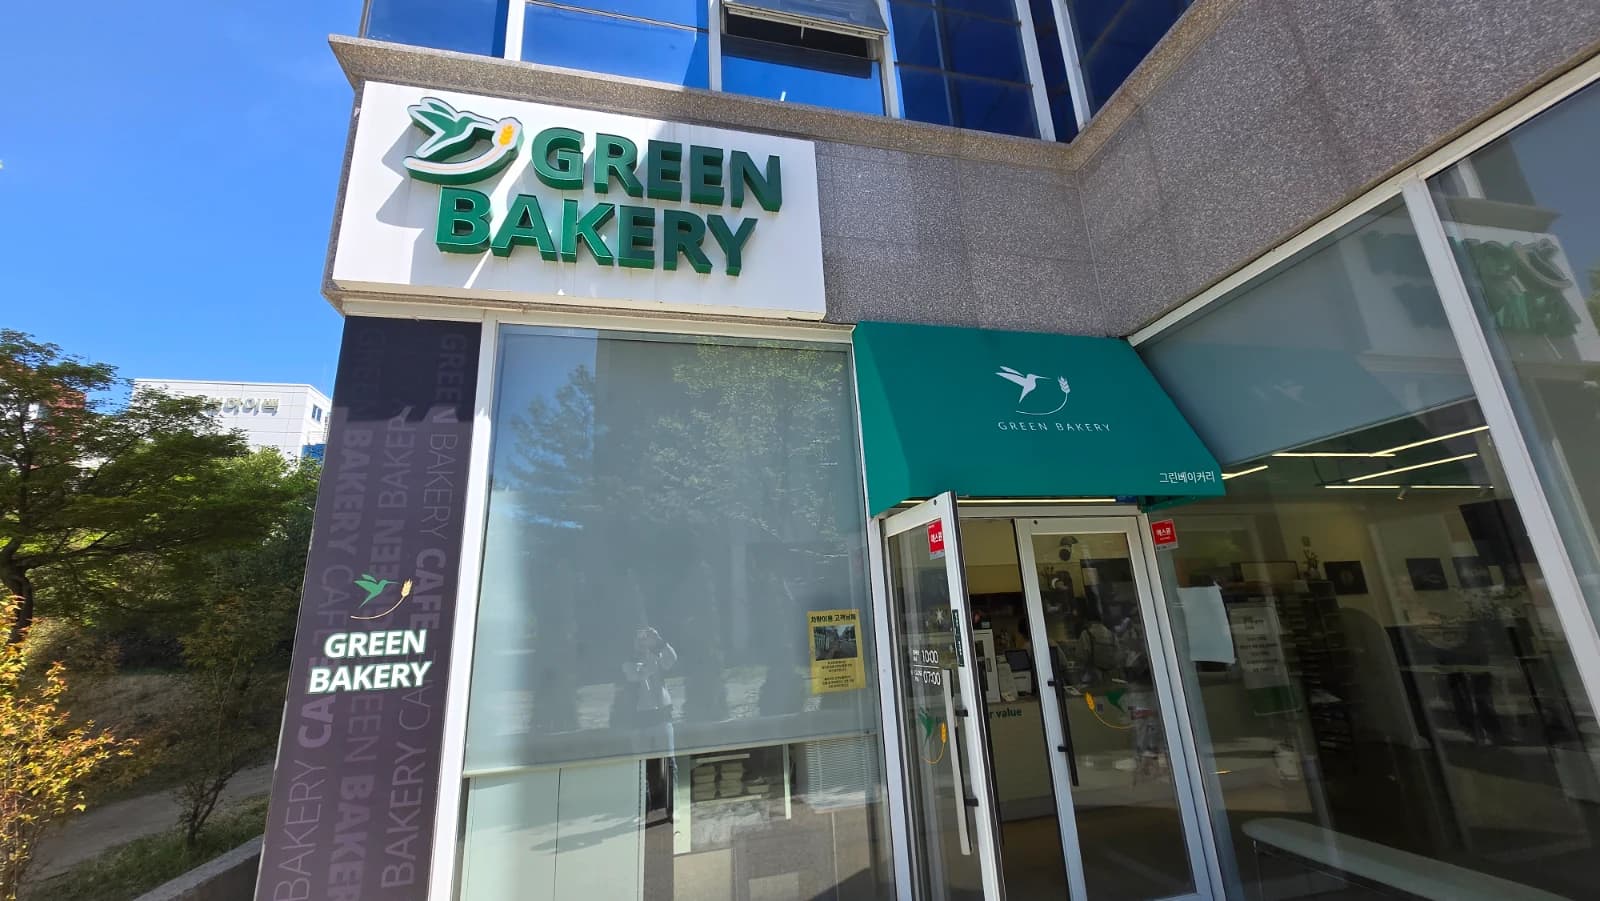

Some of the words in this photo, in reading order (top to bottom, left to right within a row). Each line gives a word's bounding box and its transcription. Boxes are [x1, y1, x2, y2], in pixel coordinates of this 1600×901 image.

[530, 127, 783, 213] GREEN
[435, 187, 758, 277] BAKERY
[430, 333, 467, 424] GREEN
[998, 421, 1048, 432] GREEN
[1056, 422, 1111, 433] BAKERY
[327, 429, 374, 557] BAKERY
[420, 433, 458, 541] BAKERY
[1159, 471, 1215, 483] 그린베이커리
[409, 547, 447, 629] CAFE
[308, 661, 432, 694] BAKERY
[324, 629, 427, 658] GREEN
[997, 707, 1022, 718] value
[380, 741, 427, 889] BAKERY
